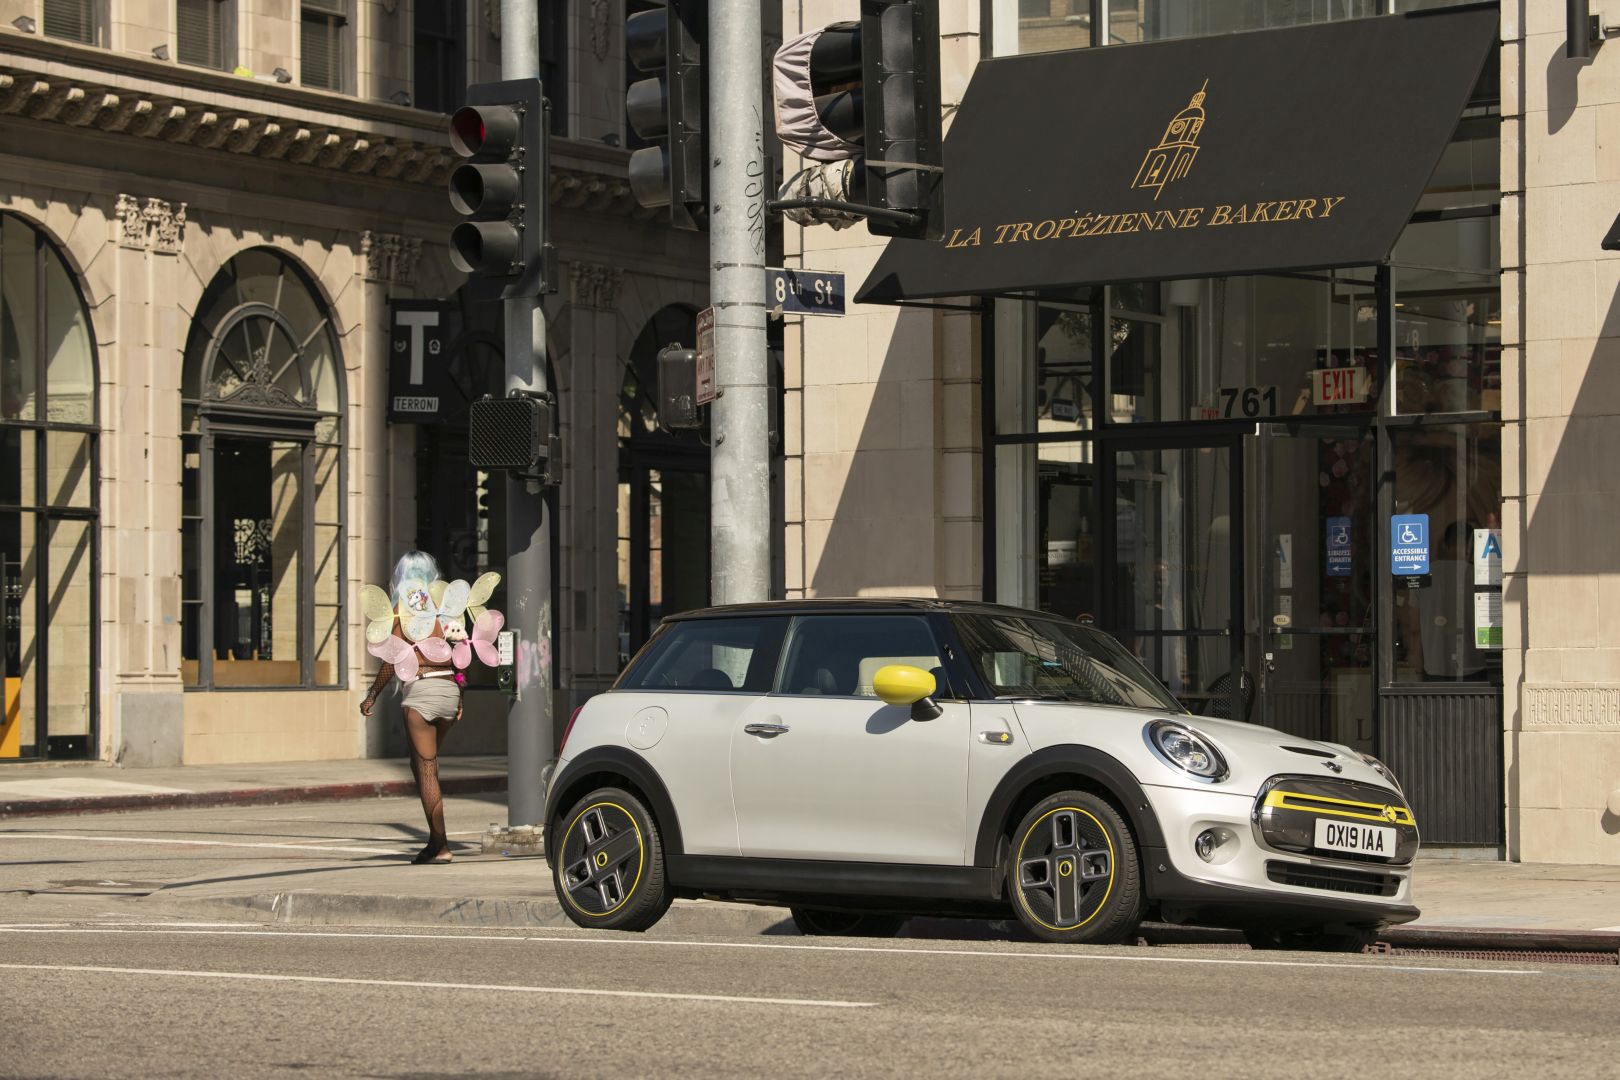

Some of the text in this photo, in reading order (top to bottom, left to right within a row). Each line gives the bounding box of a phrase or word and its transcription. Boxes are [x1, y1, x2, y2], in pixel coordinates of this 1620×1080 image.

[945, 196, 1346, 249] LA TROPÉZIENNE BAKERY
[775, 276, 834, 305] 8th St
[396, 311, 440, 385] T
[1322, 369, 1356, 401] EXIT
[396, 398, 438, 411] TERRONI
[1220, 386, 1277, 418] 761
[1392, 547, 1428, 555] ACCESSIBLE
[1481, 533, 1502, 559] A
[1326, 824, 1358, 848] OX19
